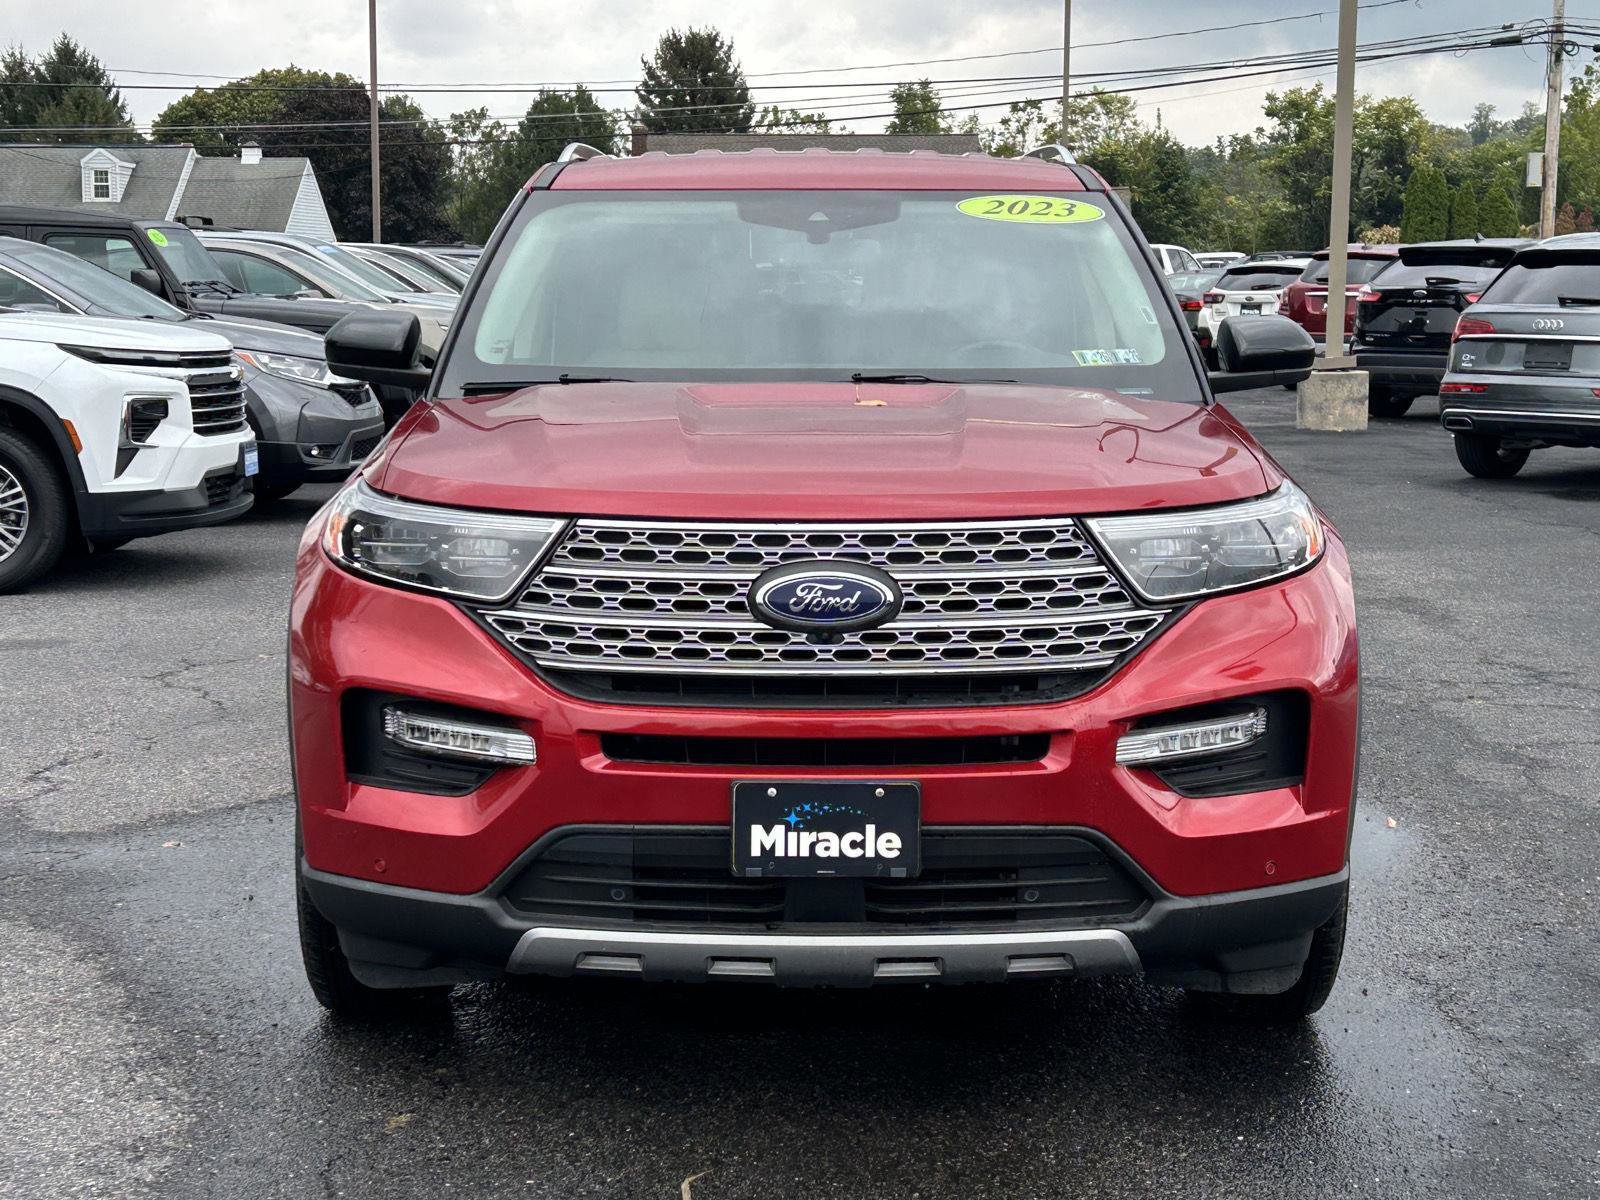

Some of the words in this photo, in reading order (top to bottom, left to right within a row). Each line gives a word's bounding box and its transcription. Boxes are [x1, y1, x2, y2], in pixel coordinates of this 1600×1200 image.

[982, 200, 1077, 217] 2023
[789, 582, 861, 612] Ford
[751, 824, 902, 858] Miracle
